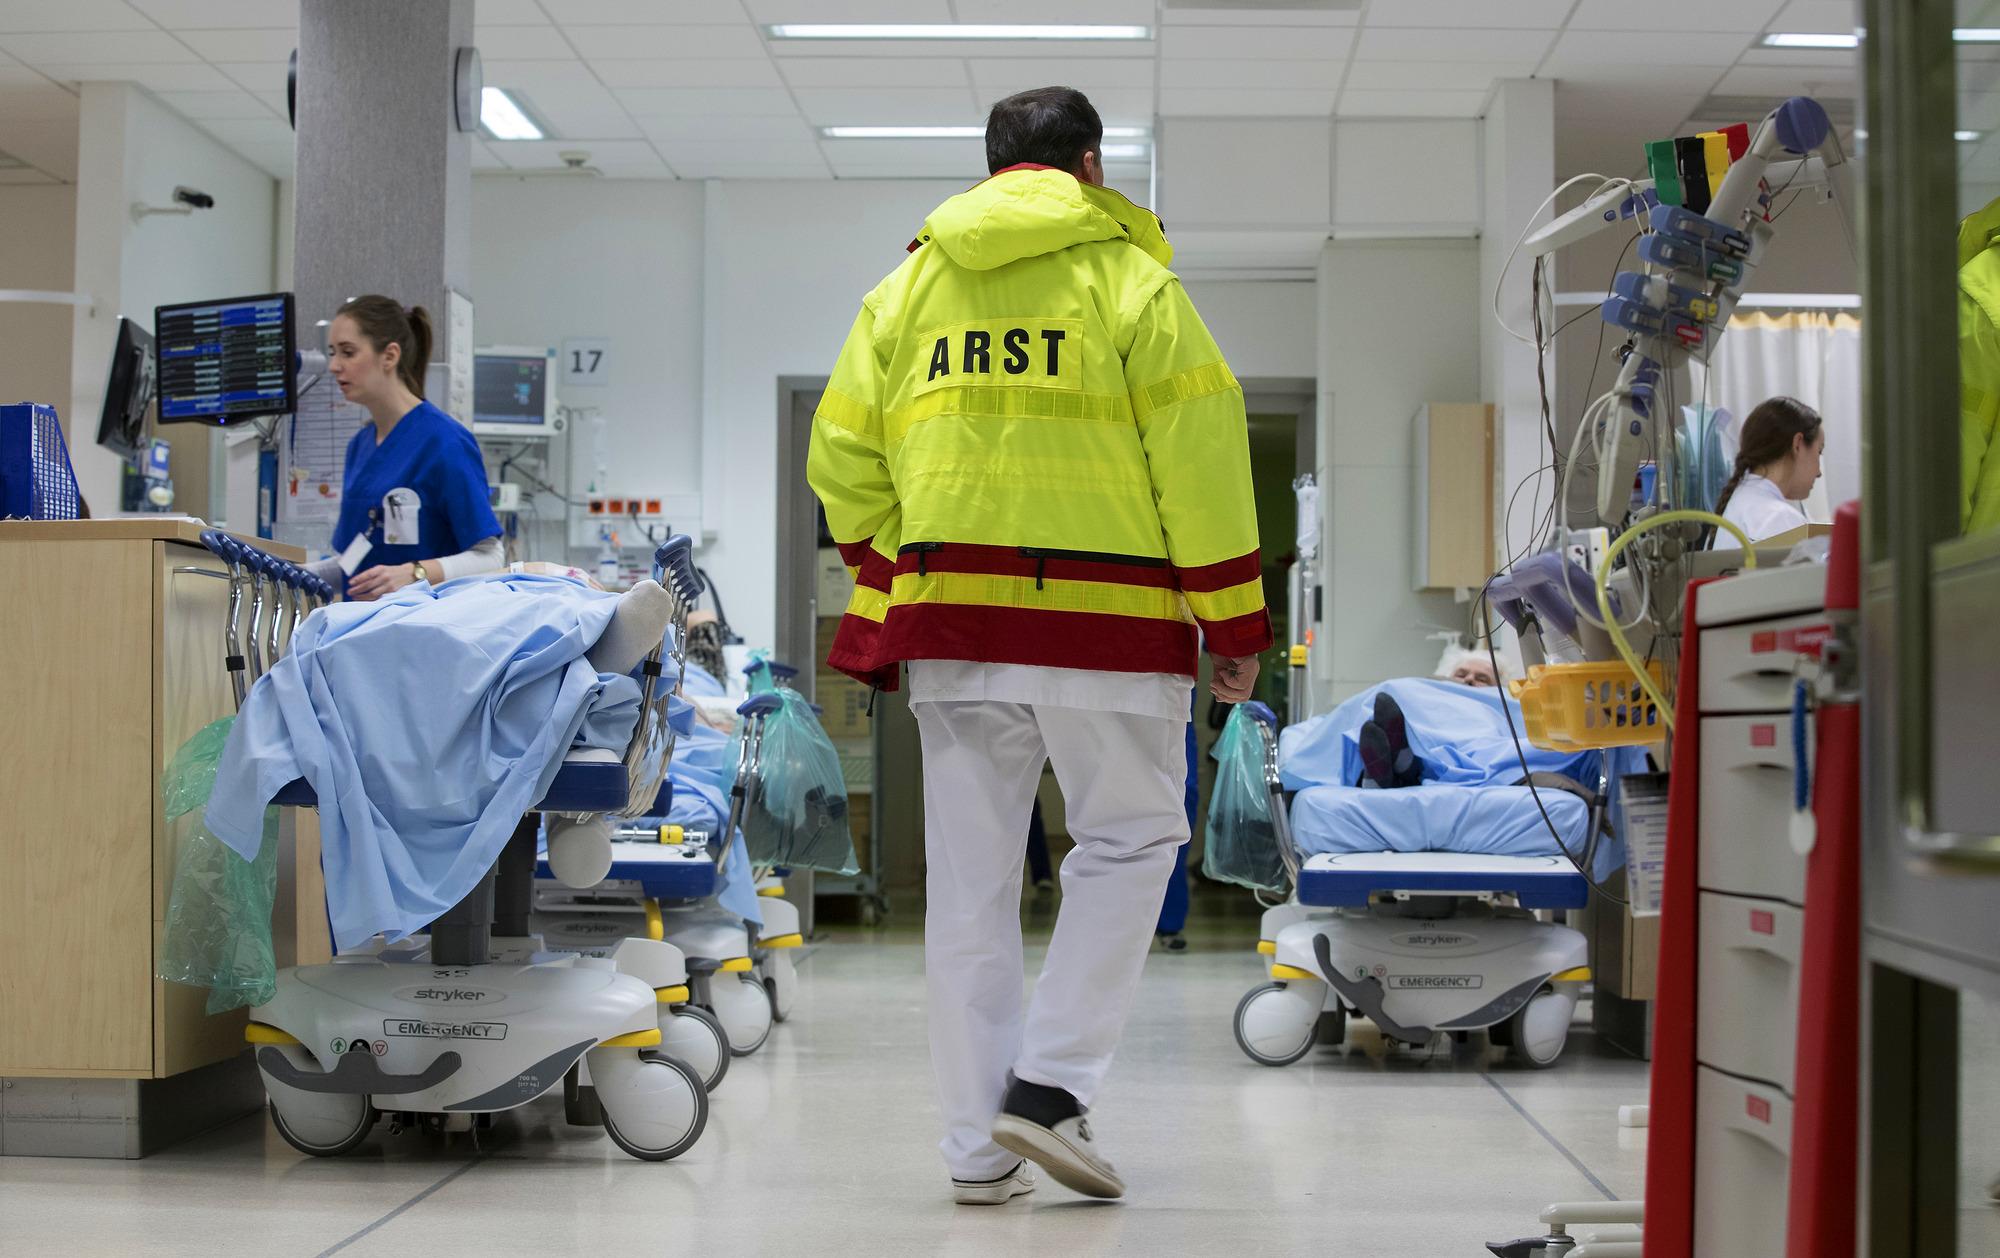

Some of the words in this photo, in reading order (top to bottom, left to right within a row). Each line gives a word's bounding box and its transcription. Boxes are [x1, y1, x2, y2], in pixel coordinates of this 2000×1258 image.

[571, 349, 603, 373] 17
[927, 328, 1066, 382] ARST
[1408, 935, 1462, 945] stryker
[1400, 977, 1471, 987] EMERGENCY
[414, 988, 486, 1002] stryker
[398, 1022, 492, 1037] EMERGENCY
